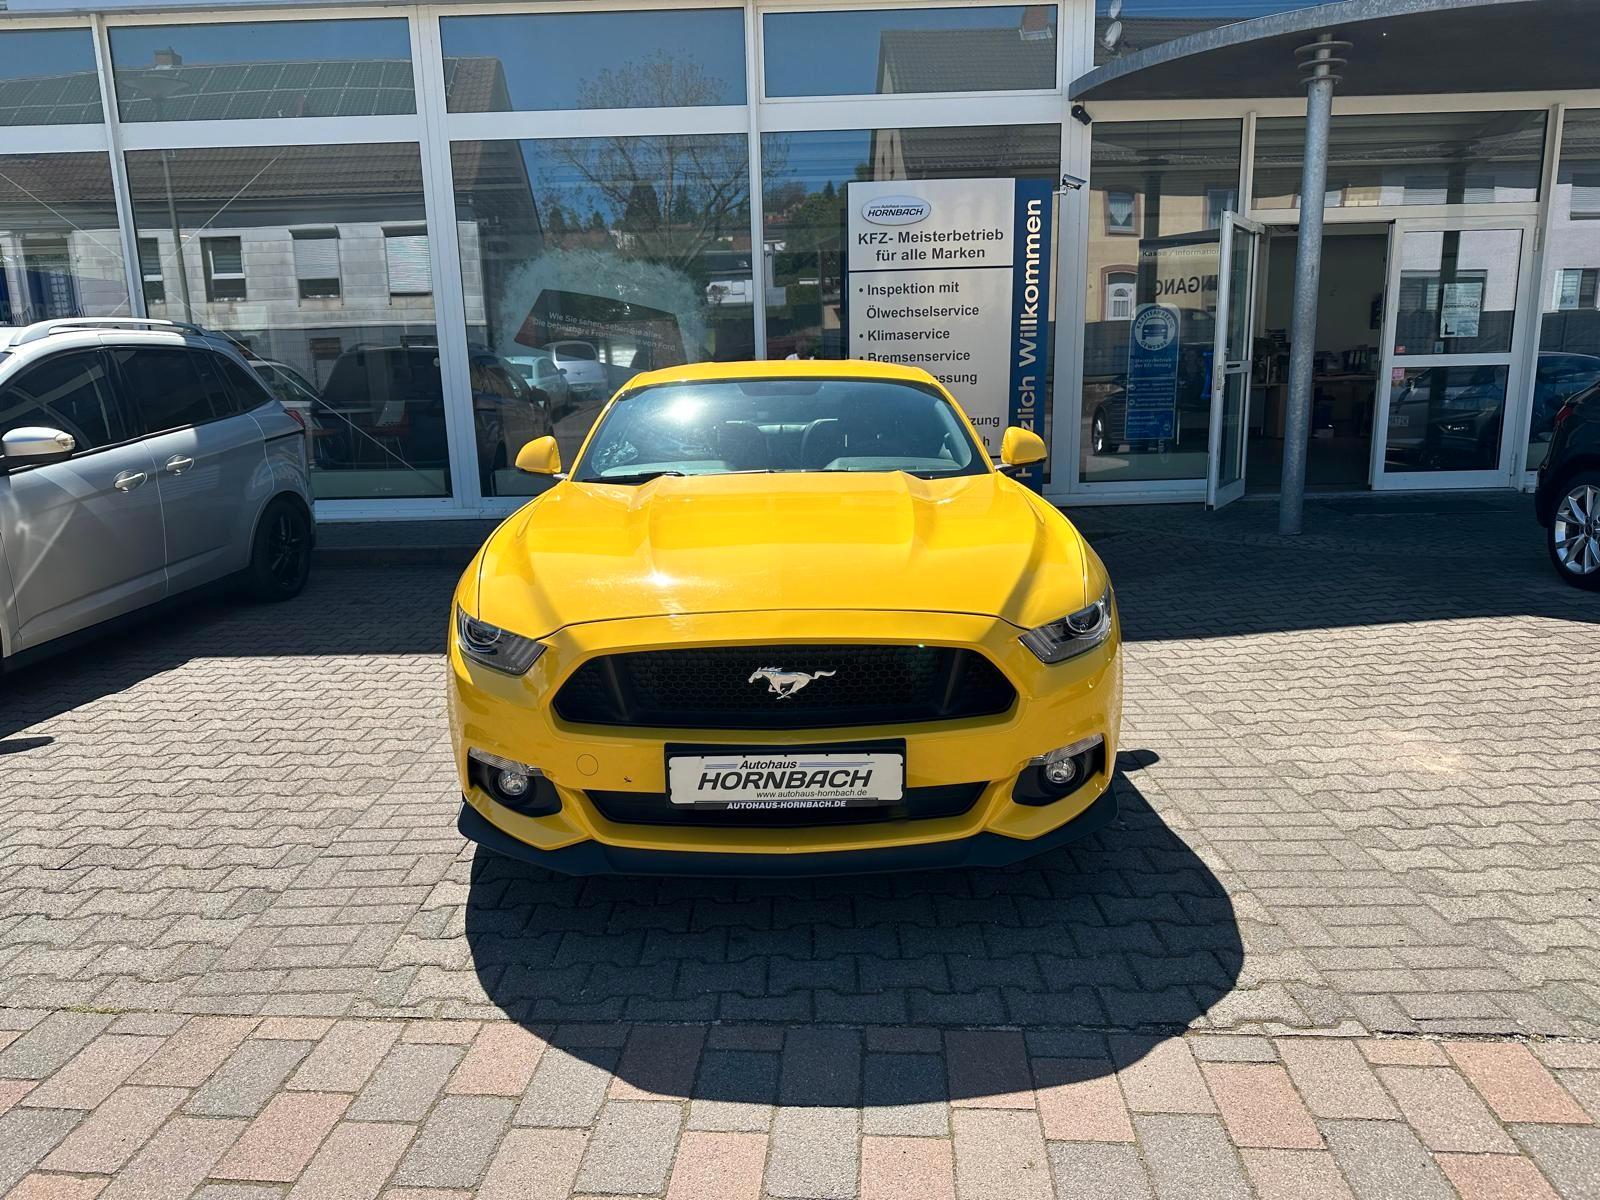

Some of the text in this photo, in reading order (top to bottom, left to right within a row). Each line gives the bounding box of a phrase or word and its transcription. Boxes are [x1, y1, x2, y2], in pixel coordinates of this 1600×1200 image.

[867, 208, 924, 217] HORNBACH
[858, 229, 1004, 245] KFZ- Meisterbetrieb
[875, 247, 985, 262] für alle Marken
[867, 281, 960, 298] Inspektion mit
[549, 311, 564, 321] Wie
[565, 314, 578, 323] Sie
[866, 305, 980, 319] Ölwechselservice
[867, 328, 950, 341] Klimaservice
[1016, 199, 1042, 478] Hzlich Willkommen
[867, 350, 971, 363] Bremsenservice
[739, 759, 798, 770] Autohaus
[697, 769, 873, 791] HORNBACH
[756, 789, 868, 798] www.autohaus-hornbach.de
[726, 800, 847, 810] AUTOHAUS-HORNBACH.DE
